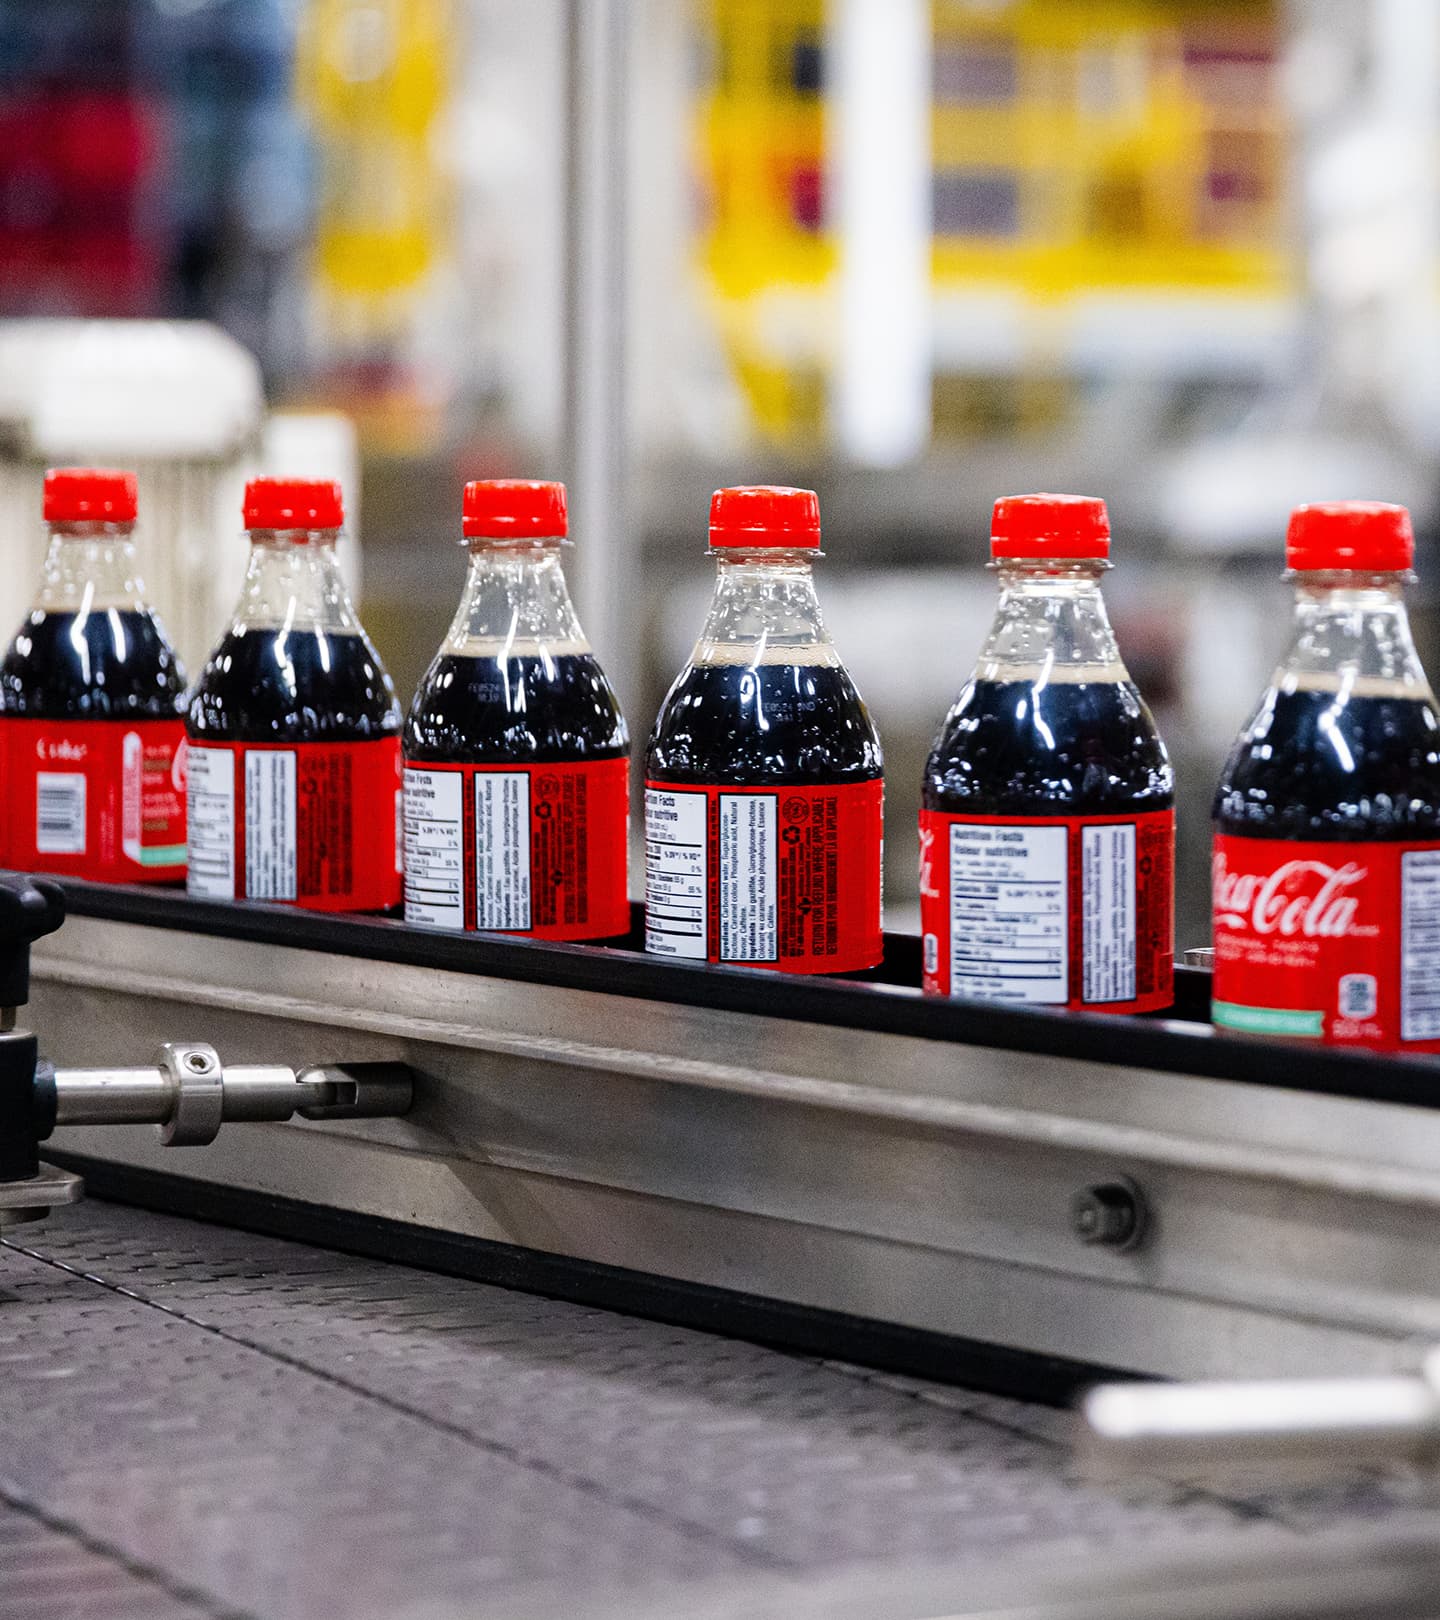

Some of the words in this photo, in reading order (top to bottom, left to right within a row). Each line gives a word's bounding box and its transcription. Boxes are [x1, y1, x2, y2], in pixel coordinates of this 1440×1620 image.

[758, 802, 766, 828] Essence
[812, 798, 824, 843] APPLICABLE
[812, 846, 824, 873] WHERE
[758, 876, 766, 893] Acide
[812, 874, 824, 905] REFUND
[758, 895, 766, 921] caramel,
[812, 907, 824, 922] FOR
[812, 924, 824, 955] RETURN
